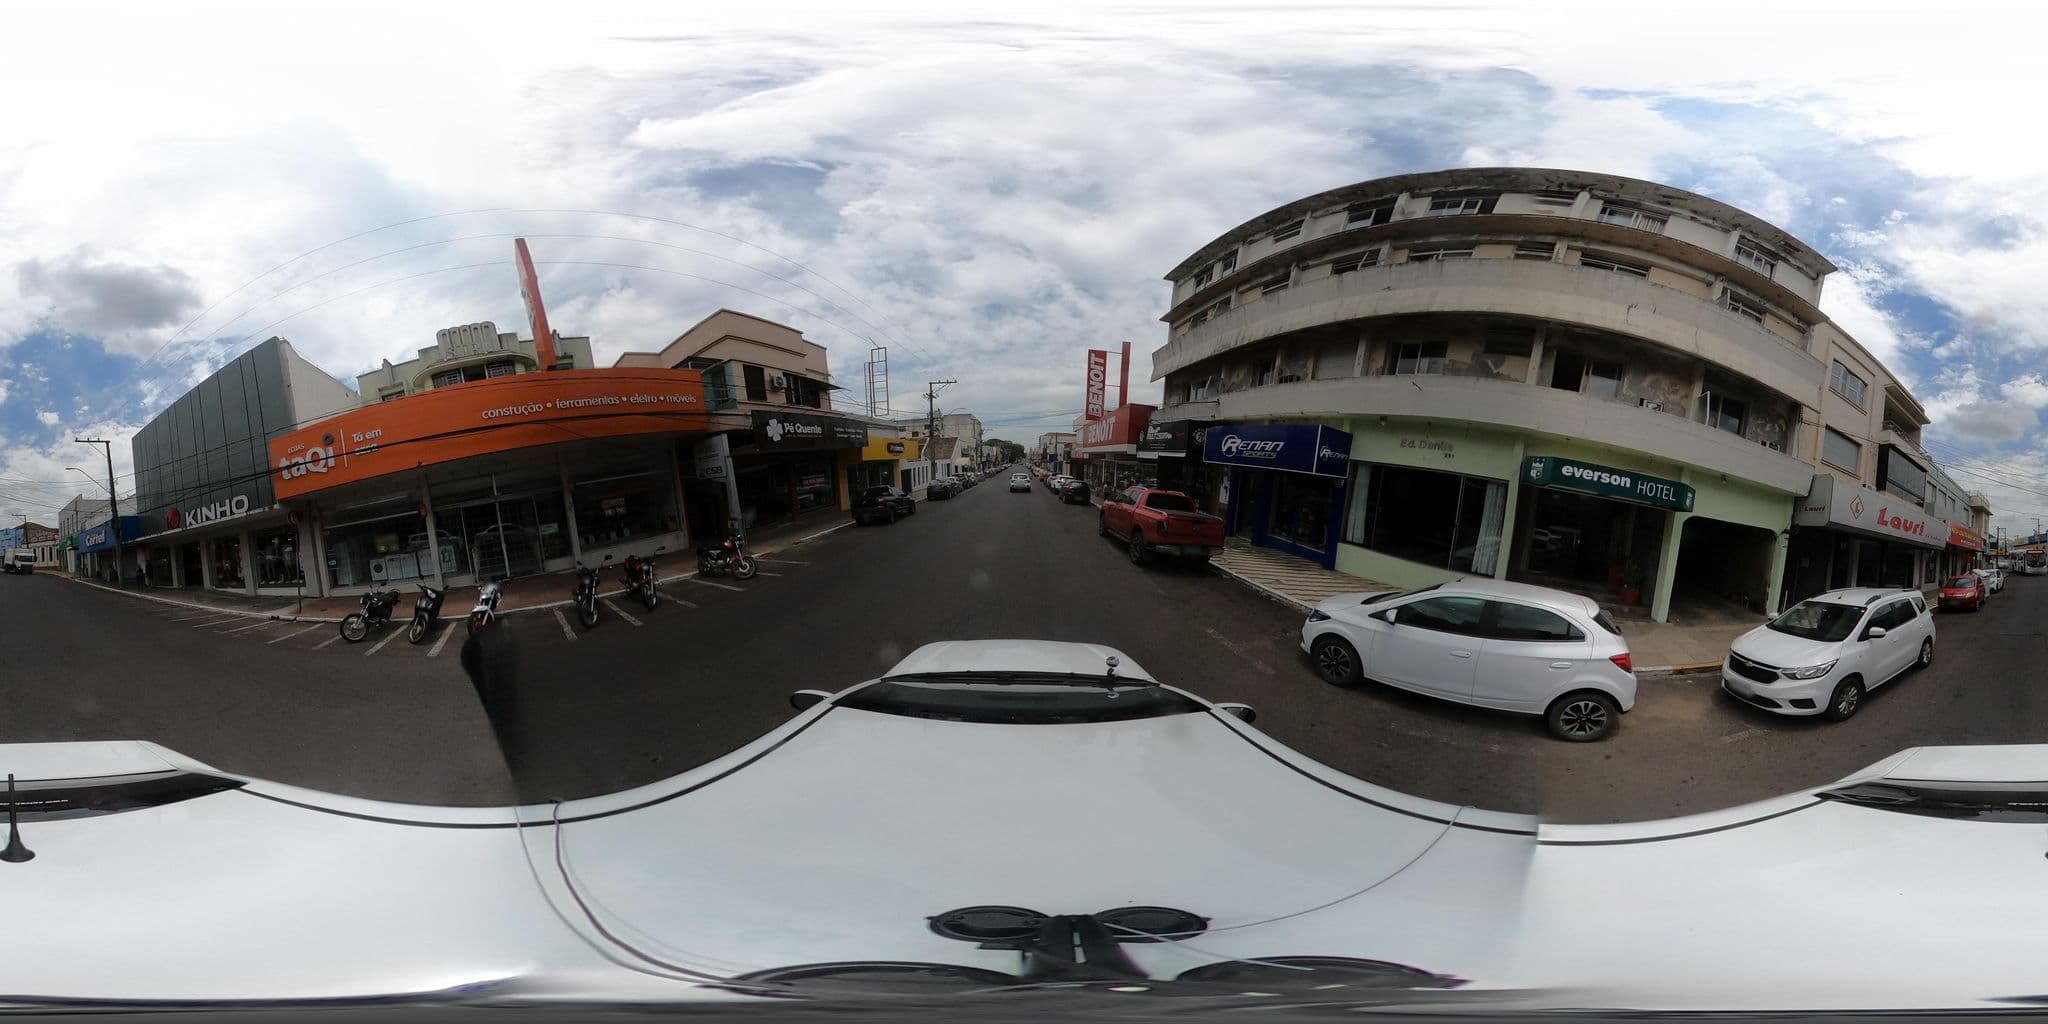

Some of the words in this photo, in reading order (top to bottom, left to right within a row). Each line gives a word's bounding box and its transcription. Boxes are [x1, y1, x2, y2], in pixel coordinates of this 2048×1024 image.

[1088, 353, 1104, 417] BENOIT
[556, 395, 620, 409] ferramentas
[629, 393, 658, 404] eletro
[666, 394, 697, 403] móveis
[352, 432, 364, 442] Tá
[365, 428, 382, 439] em
[784, 422, 795, 433] Pé
[795, 423, 822, 434] Quente
[1087, 416, 1116, 443] BENOIT
[279, 446, 335, 480] taQi
[1561, 465, 1631, 488] everson
[1637, 480, 1676, 501] HOTEL
[185, 495, 249, 526] KINHO
[1877, 507, 1925, 536] Lauri
